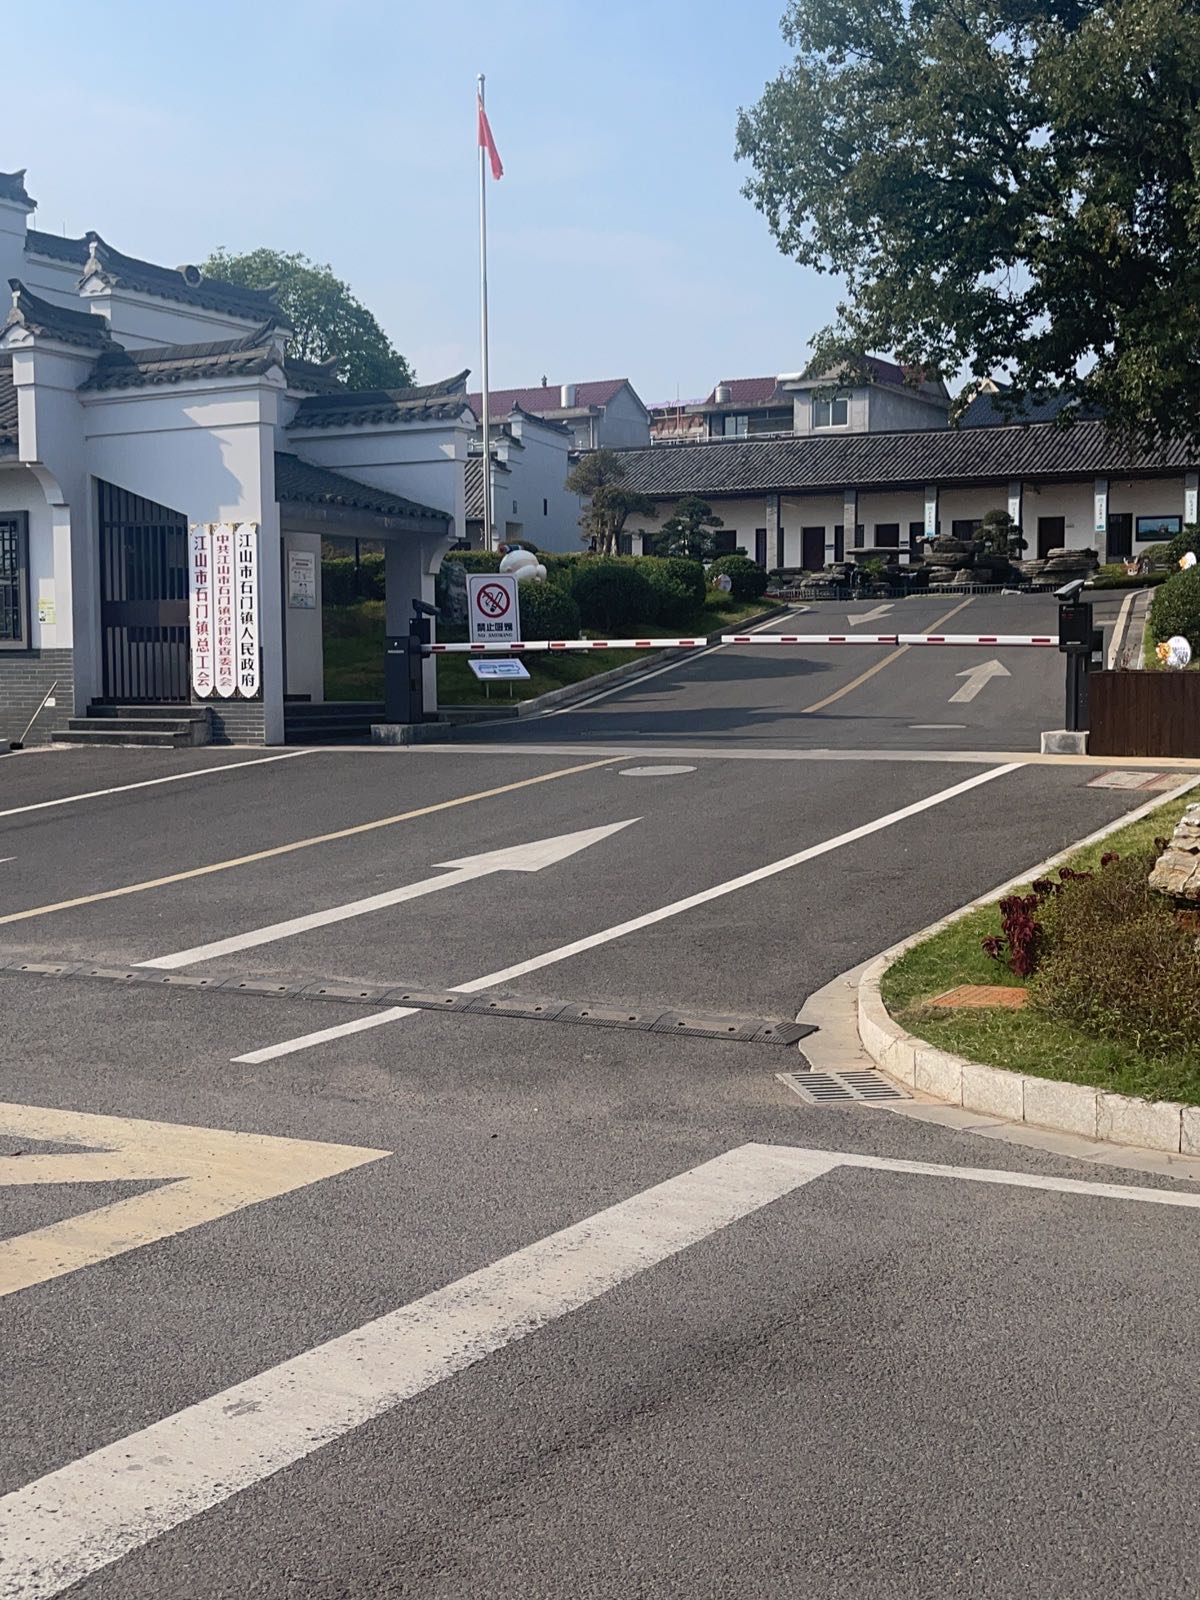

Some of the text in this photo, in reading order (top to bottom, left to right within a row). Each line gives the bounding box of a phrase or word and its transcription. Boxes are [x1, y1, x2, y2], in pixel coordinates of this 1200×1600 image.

[194, 535, 210, 687] 江山市石门镇总工会
[216, 534, 232, 687] 中共江山市石门镇纪律检查委员会
[239, 533, 255, 687] 江山市石门镇人民政府
